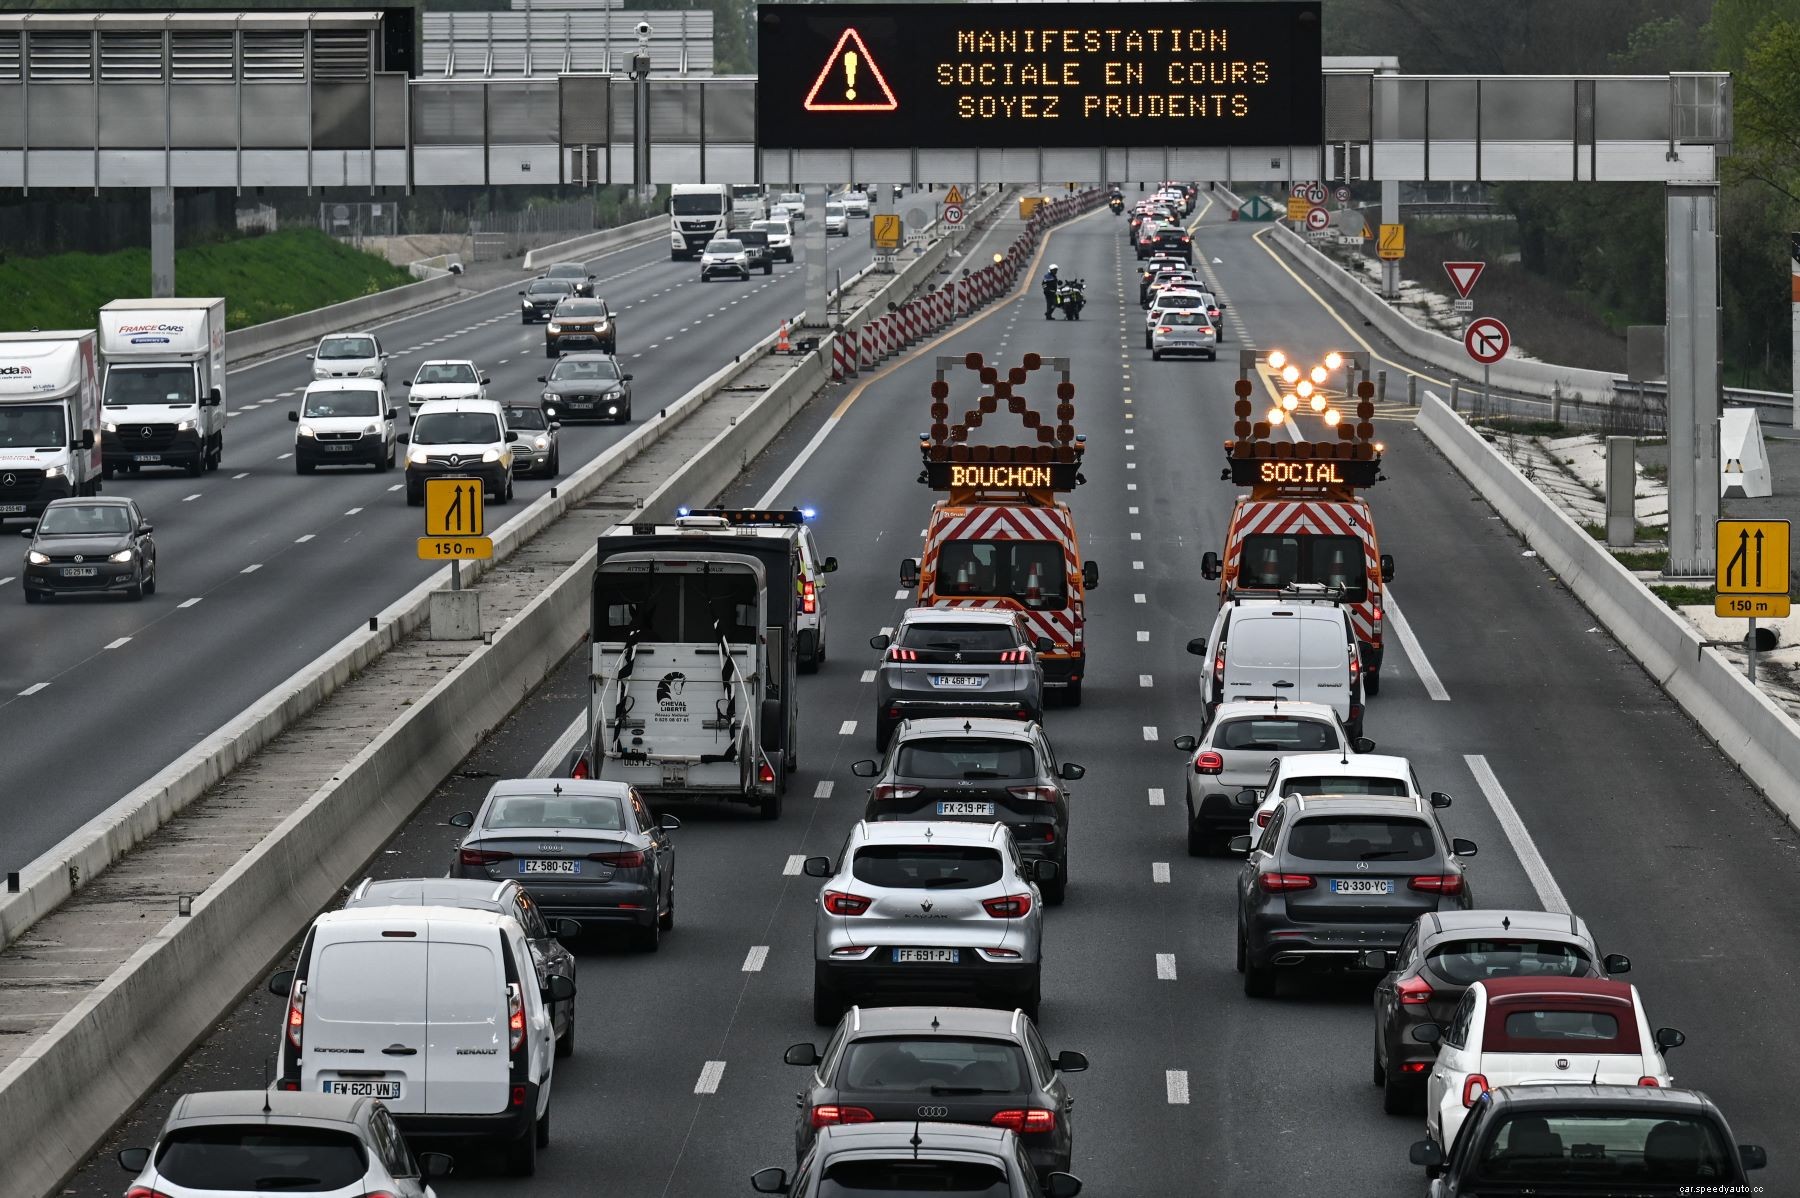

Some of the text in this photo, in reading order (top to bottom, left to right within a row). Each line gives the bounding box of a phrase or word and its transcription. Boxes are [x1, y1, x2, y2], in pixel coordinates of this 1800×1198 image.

[958, 29, 1228, 53] MANIFESTATION
[937, 61, 1270, 86] SOCIALE EN COURS
[958, 94, 1249, 118] SOYEZ PRUDENTS
[1310, 190, 1323, 200] 70
[949, 210, 960, 219] 70
[119, 324, 184, 333] FRANCE CARS
[951, 465, 1051, 487] BOUCHON
[1260, 462, 1344, 483] SOCIAL
[1348, 517, 1357, 527] 22
[435, 543, 475, 555] 150 m
[1729, 600, 1768, 611] 150 m
[943, 803, 988, 813] FX-219-PF
[524, 861, 573, 872] EZ-580-GZ
[1336, 881, 1387, 892] EQ-330-YC
[900, 950, 951, 961] FF-691-PJ
[456, 1048, 498, 1056] RENAULT
[333, 1083, 389, 1096] EW-620-VN
